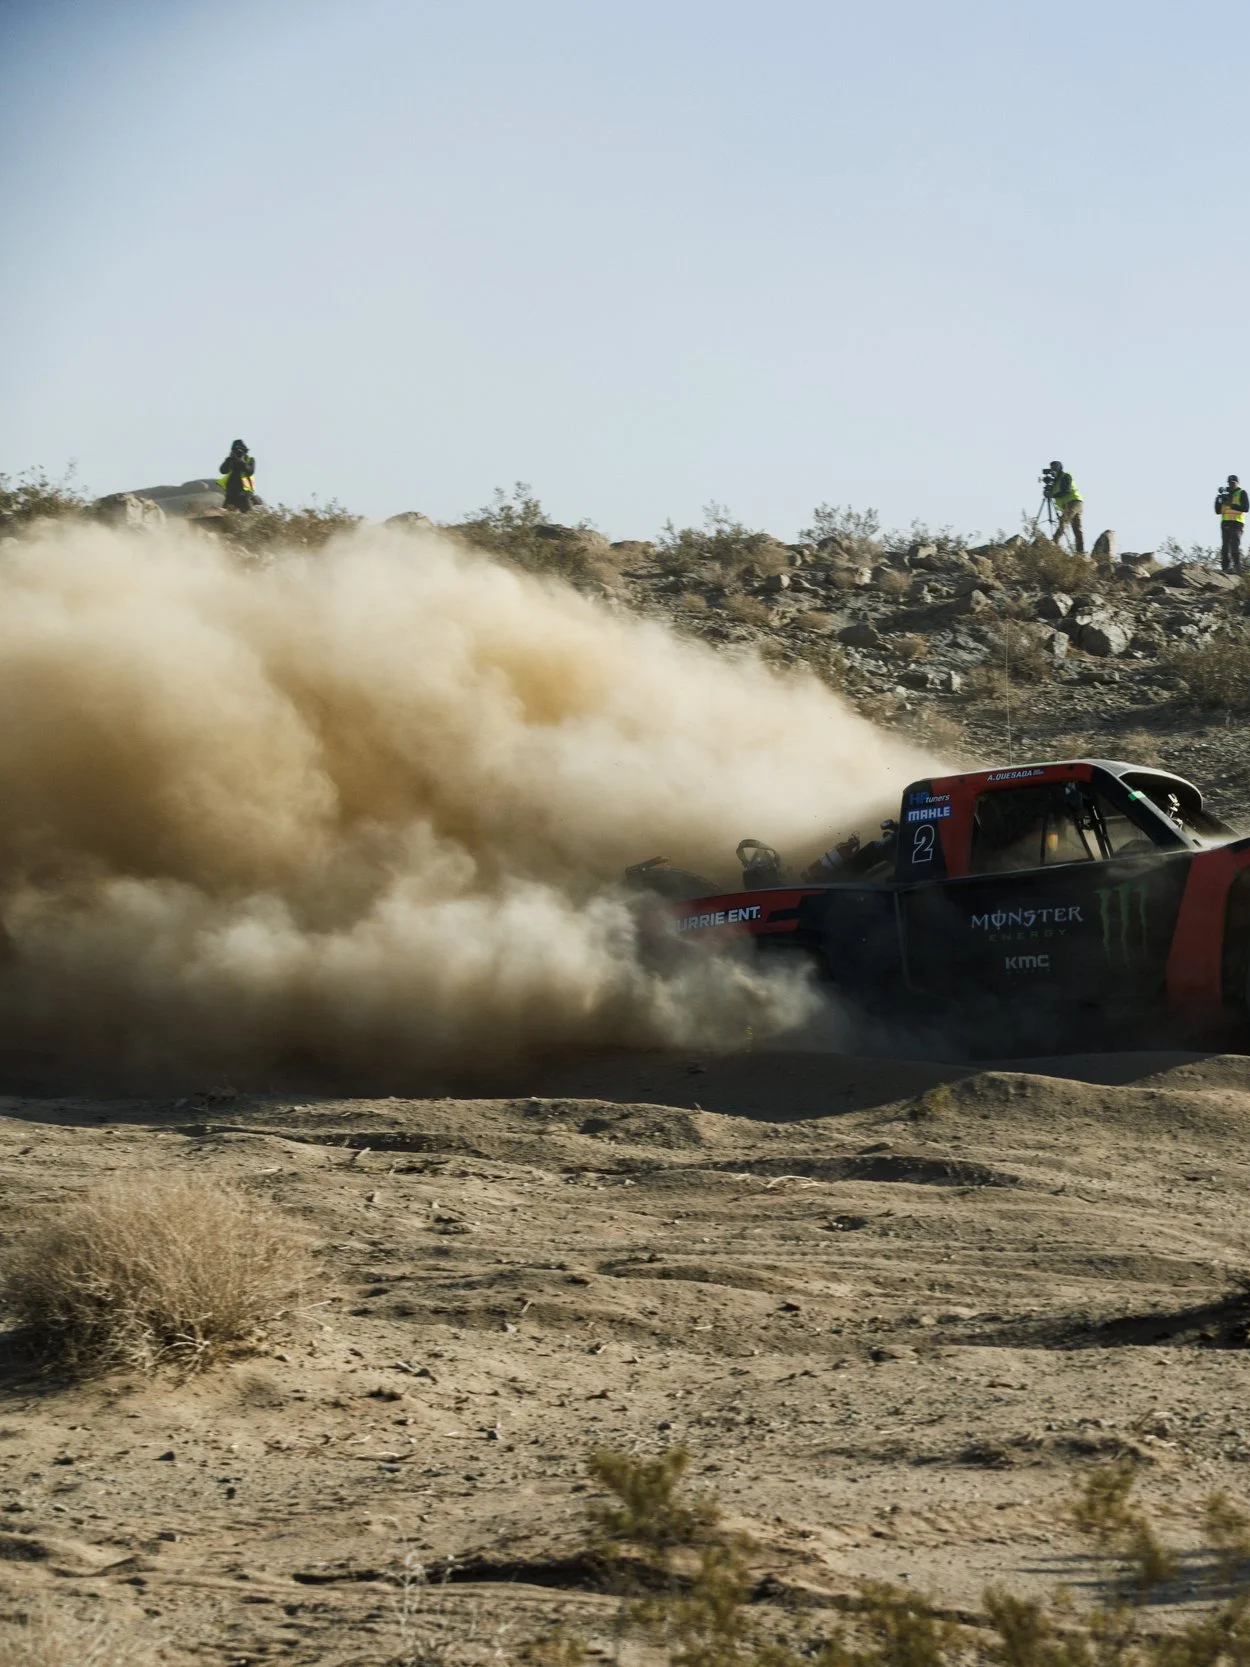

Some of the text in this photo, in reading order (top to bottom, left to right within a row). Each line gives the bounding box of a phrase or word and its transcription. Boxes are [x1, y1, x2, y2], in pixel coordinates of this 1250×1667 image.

[908, 807, 951, 822] MAHLE
[912, 825, 935, 863] 2
[669, 906, 761, 931] URRIE ENT.
[971, 906, 1084, 930] MONSTER
[1005, 954, 1050, 970] KMC
